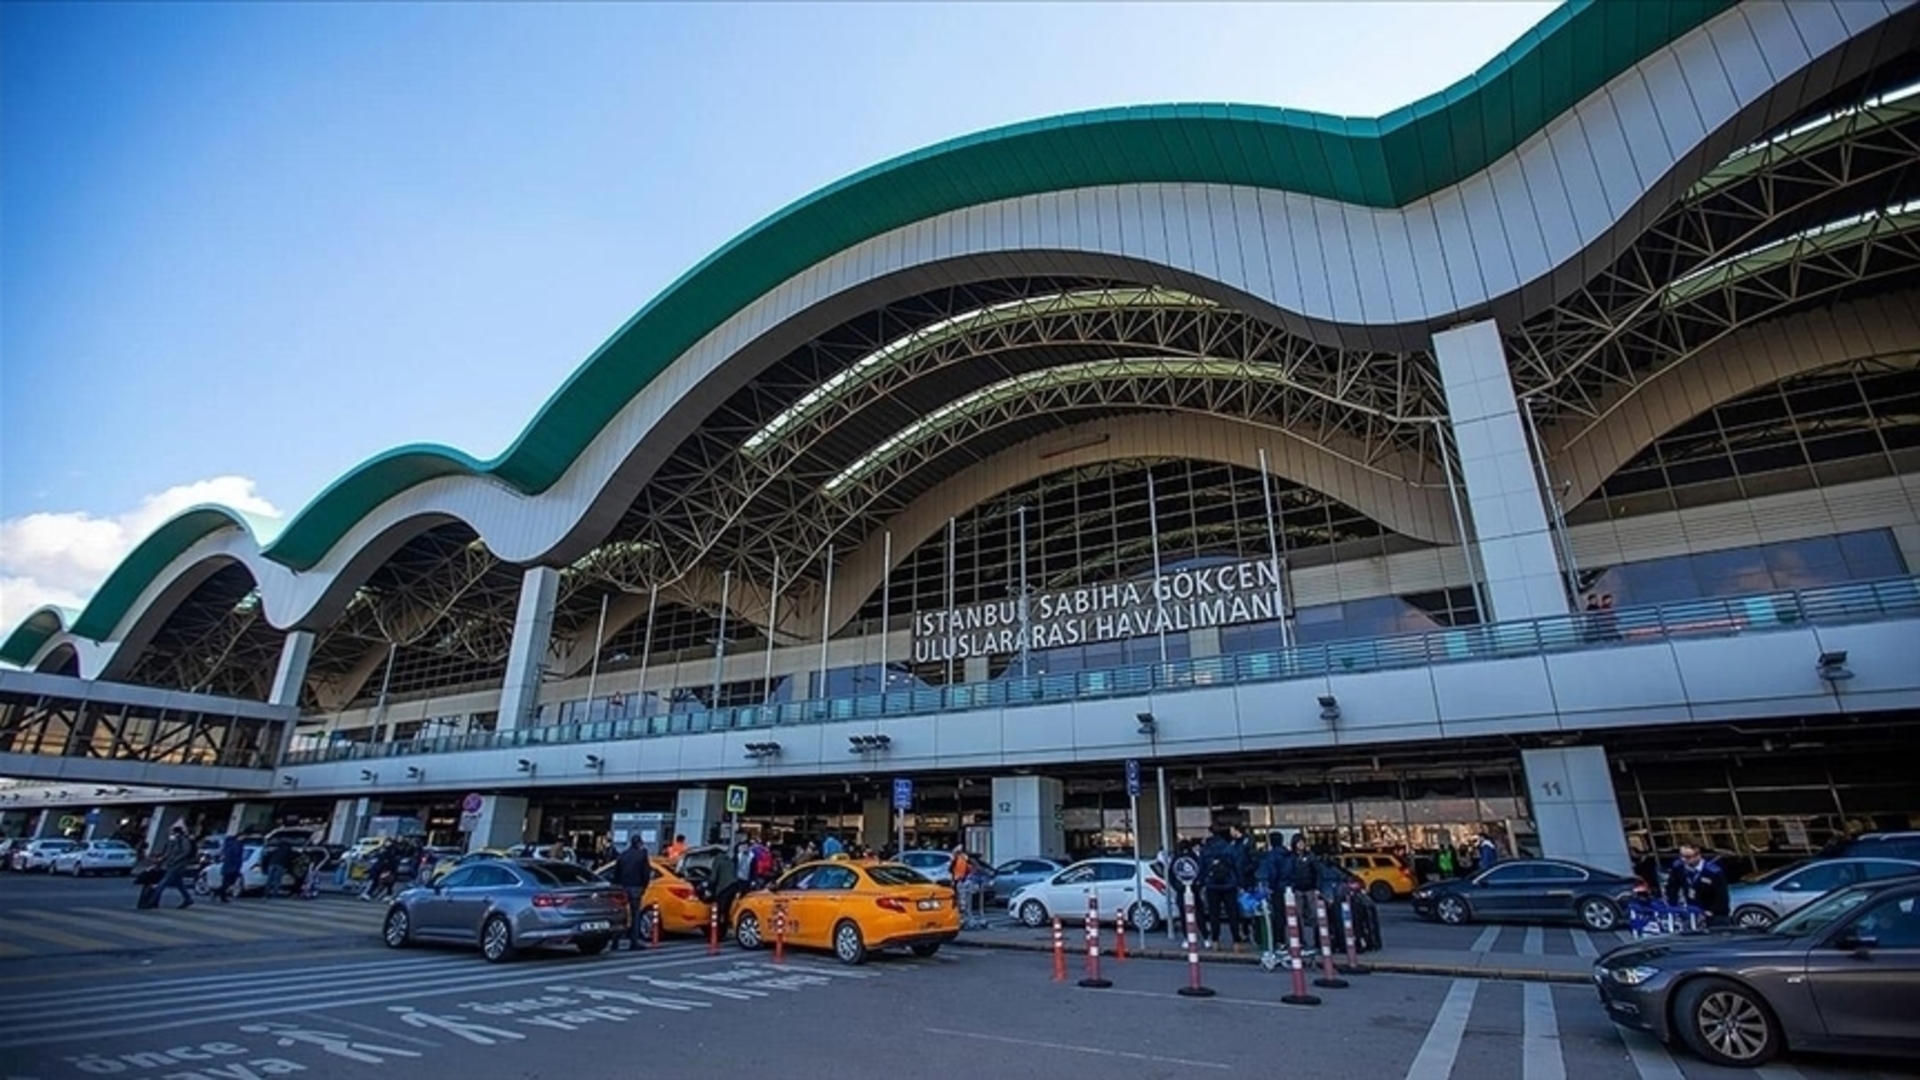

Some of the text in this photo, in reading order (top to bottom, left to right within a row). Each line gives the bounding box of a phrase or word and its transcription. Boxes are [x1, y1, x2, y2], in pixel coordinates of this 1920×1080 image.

[916, 559, 1278, 636] İSTANBU SABİHA GÖKÇEN
[915, 618, 1087, 663] ULUSLARARASI
[1542, 782, 1562, 796] 11
[998, 802, 1011, 813] 12
[63, 1041, 249, 1074] önce
